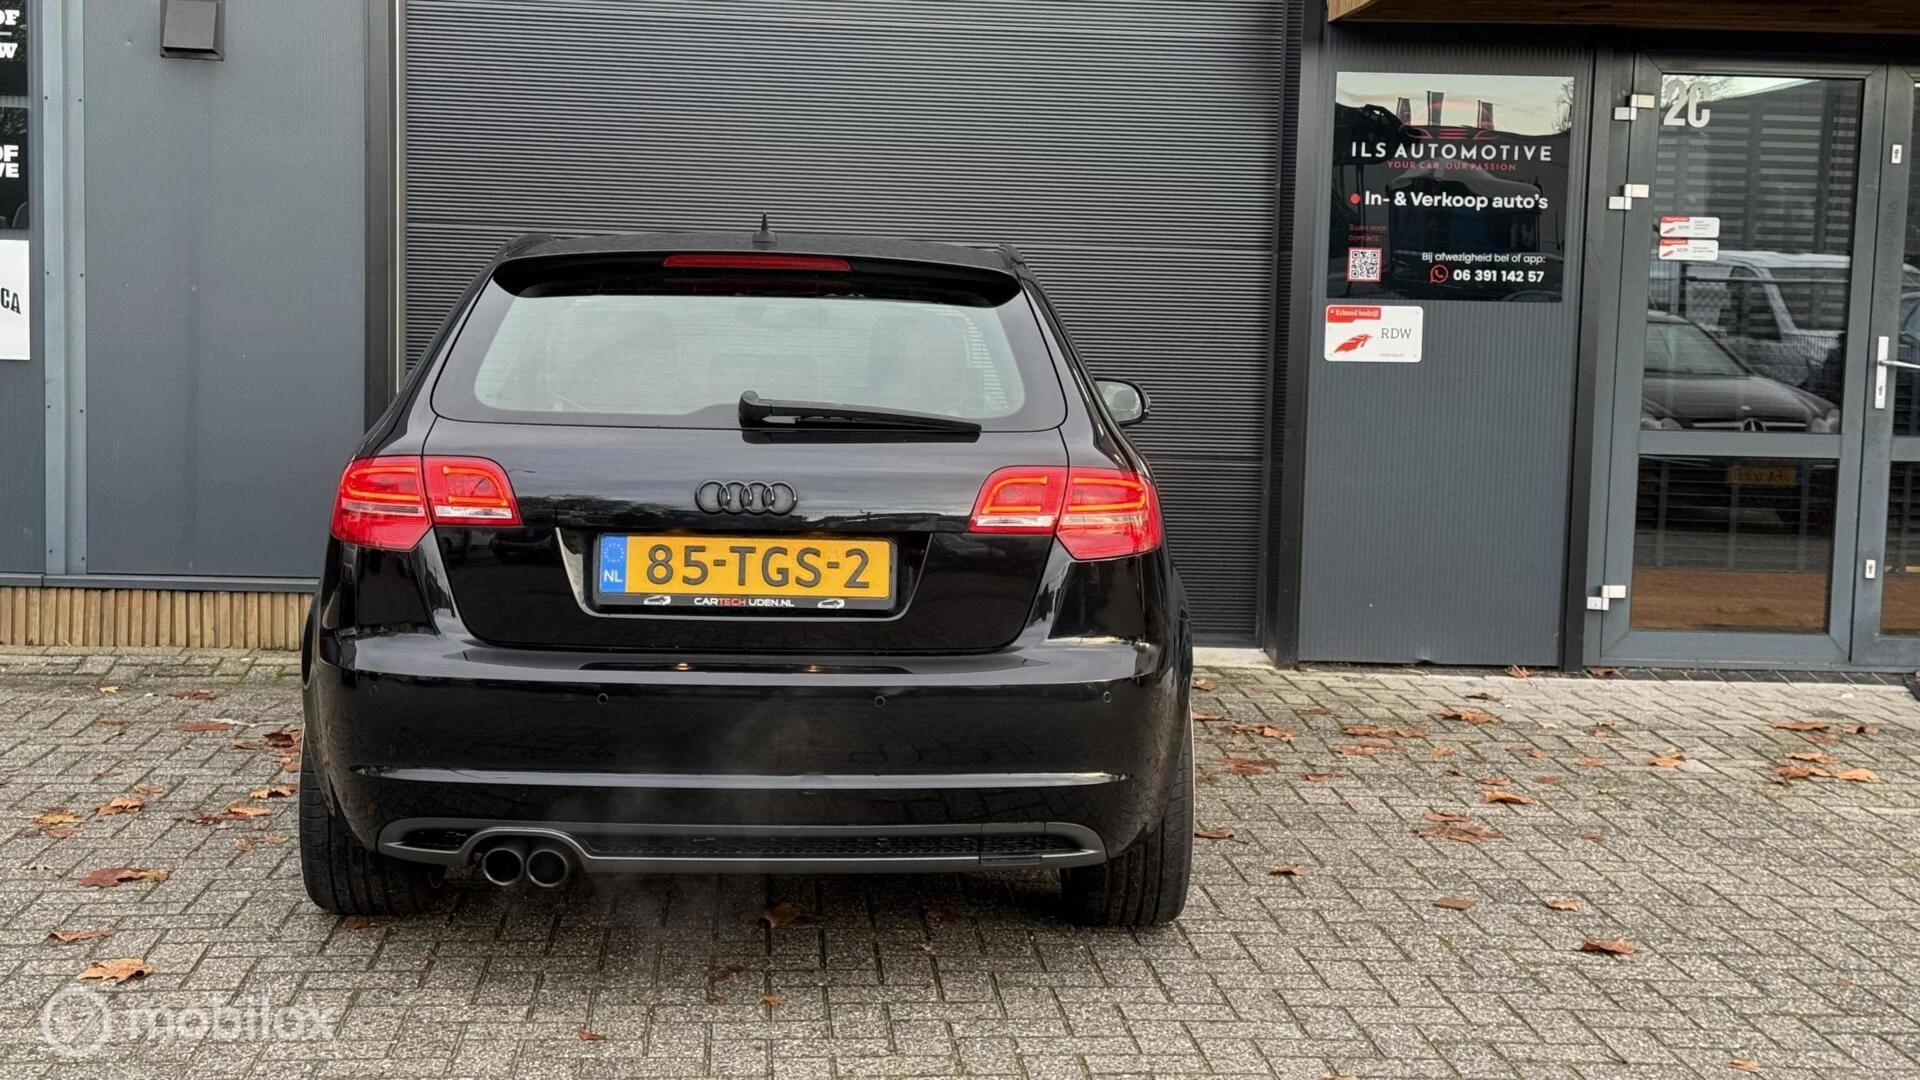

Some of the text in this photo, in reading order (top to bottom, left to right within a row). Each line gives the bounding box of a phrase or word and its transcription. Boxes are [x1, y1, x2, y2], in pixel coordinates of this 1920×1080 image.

[1663, 80, 1711, 128] 2C
[0, 145, 19, 162] F
[1351, 141, 1552, 161] ILS AUTOMOTIVE
[1387, 160, 1416, 169] YOUR
[1445, 162, 1468, 170] OUR
[1470, 162, 1516, 171] PASSION
[1365, 190, 1390, 206] In-
[1394, 191, 1407, 207] &
[1410, 191, 1489, 211] Verkoop
[1422, 252, 1546, 265] Bij afwezigheid bel of app:
[1453, 269, 1545, 283] 06 391 142 57
[1380, 327, 1412, 339] RDW
[646, 544, 870, 589] 85-TGS-2
[603, 569, 623, 583] NL
[748, 598, 795, 607] UDEN.NL
